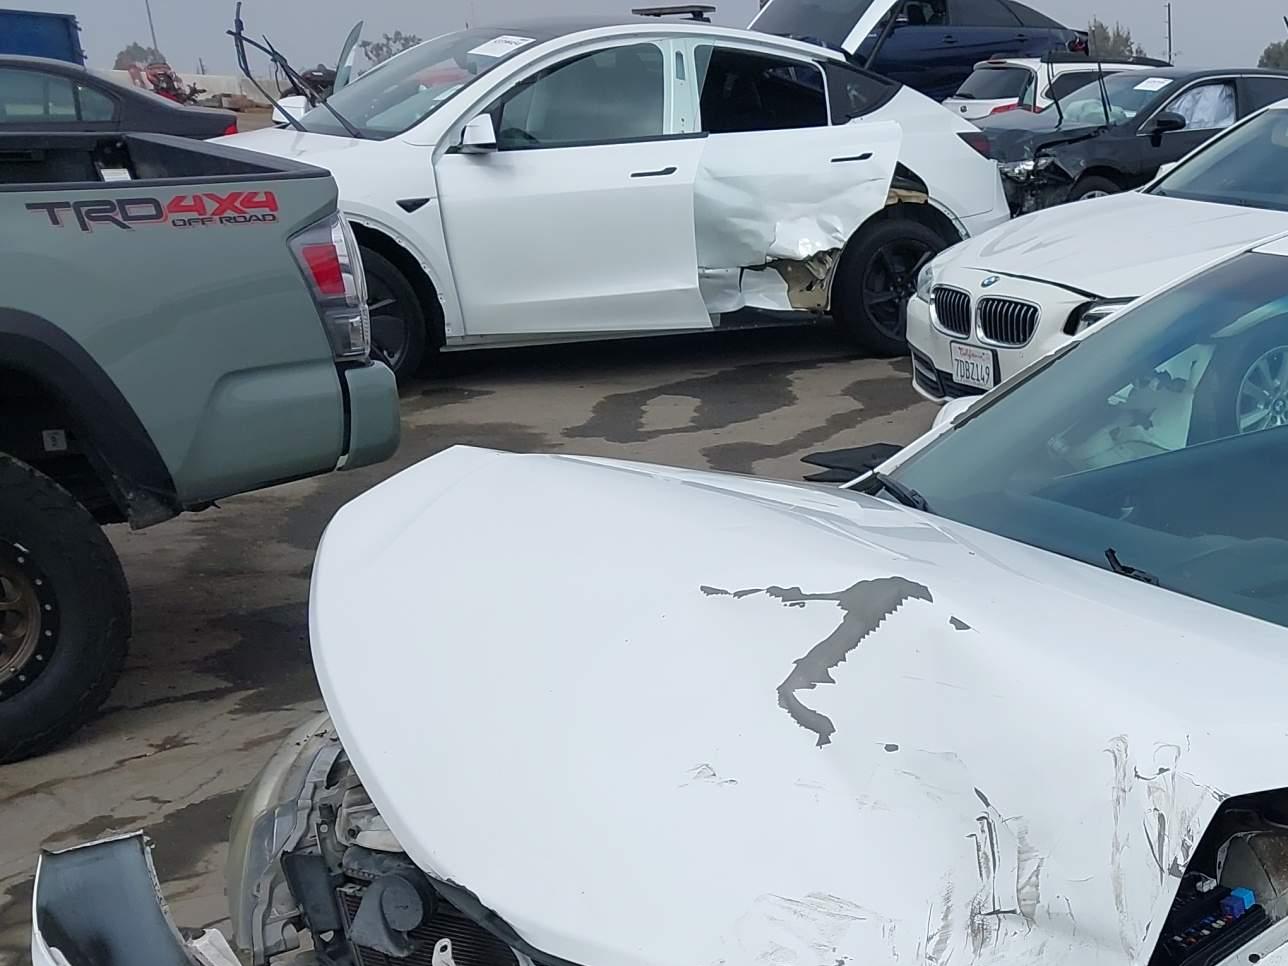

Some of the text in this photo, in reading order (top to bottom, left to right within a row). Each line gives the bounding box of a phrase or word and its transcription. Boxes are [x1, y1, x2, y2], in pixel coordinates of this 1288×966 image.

[25, 191, 279, 232] TRD 4X4
[172, 213, 277, 227] OFF ROAD
[955, 359, 990, 384] 7DBZ149
